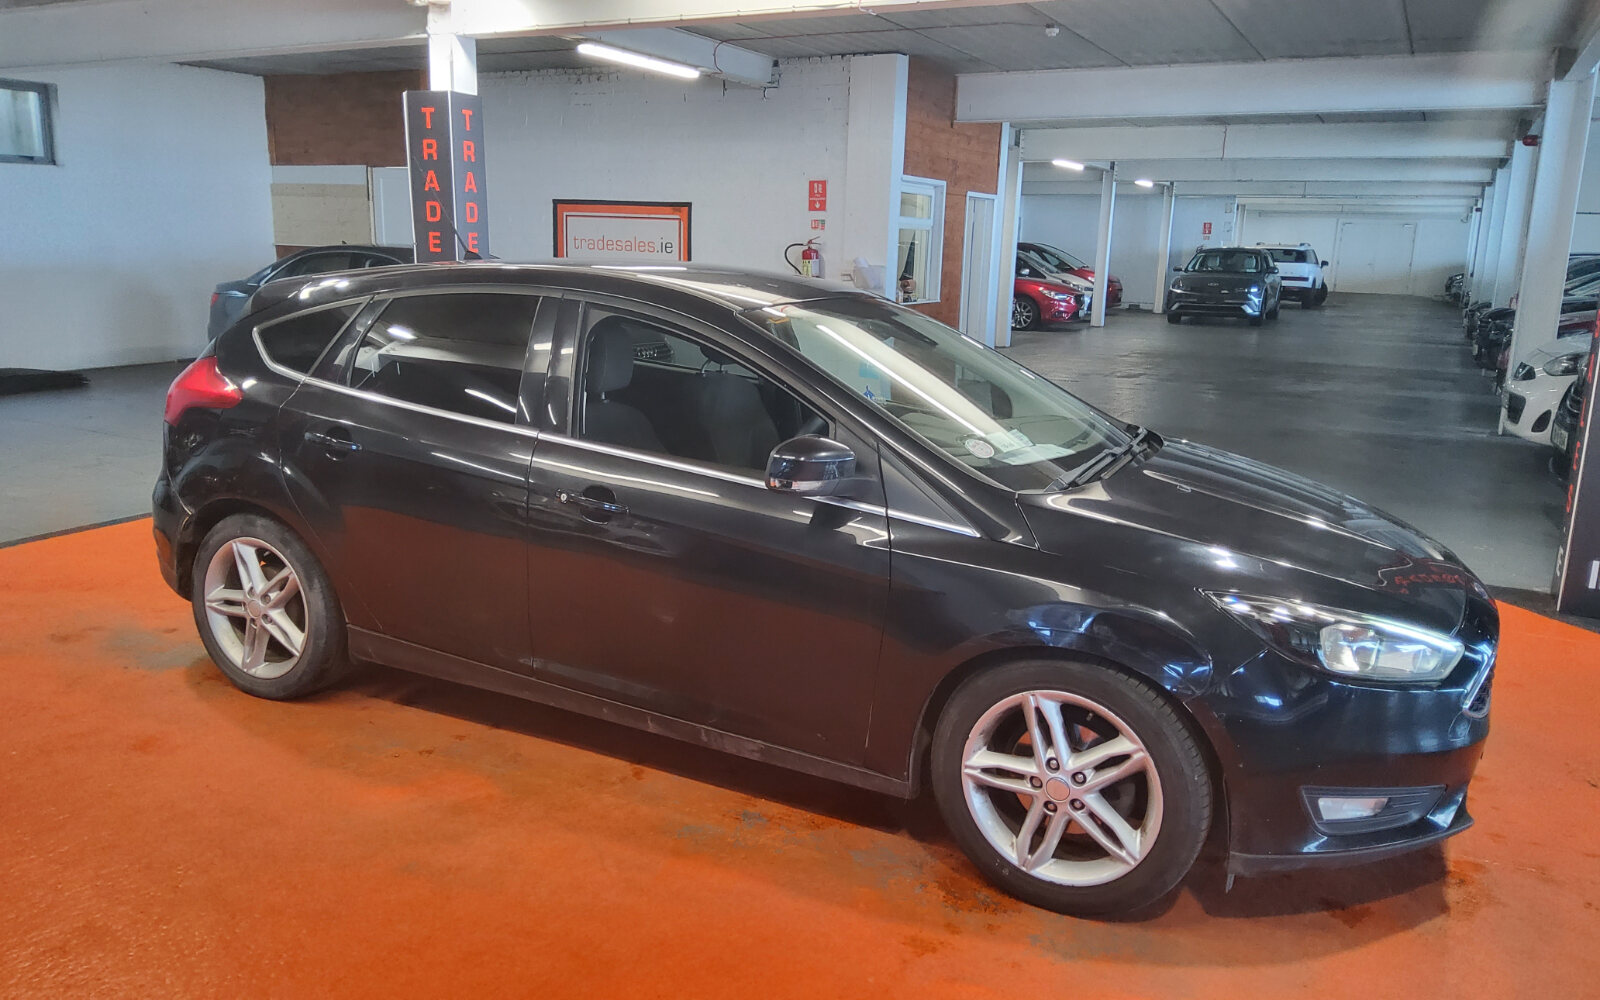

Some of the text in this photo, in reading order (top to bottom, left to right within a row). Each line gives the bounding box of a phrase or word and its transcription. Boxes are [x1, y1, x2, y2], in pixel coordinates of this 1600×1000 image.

[421, 107, 442, 253] TRADE
[461, 109, 479, 253] TRADE
[573, 235, 673, 253] tradesales.ie
